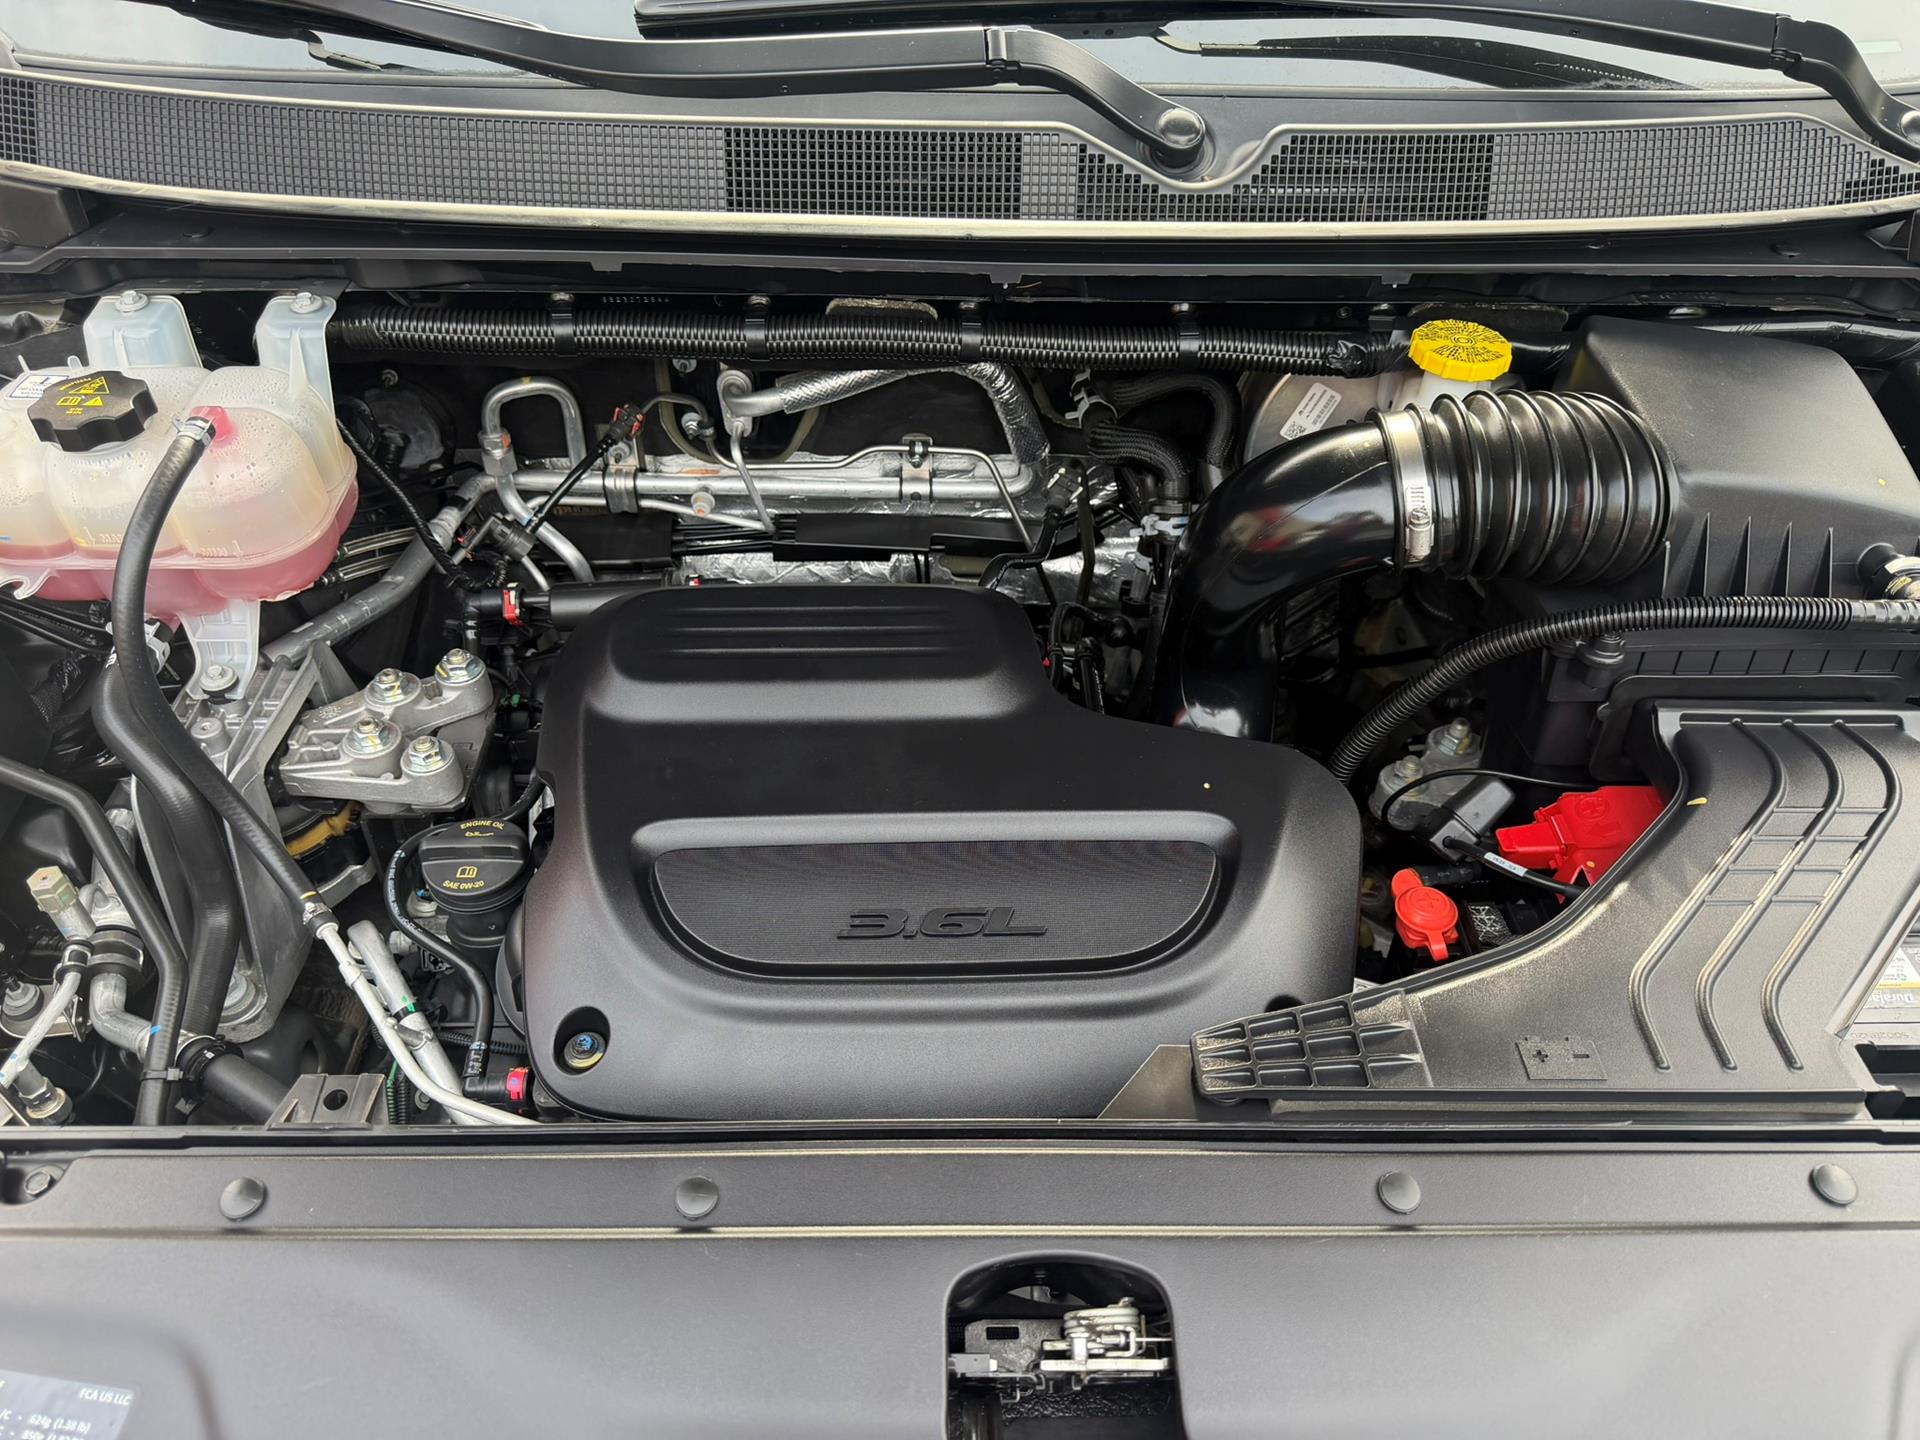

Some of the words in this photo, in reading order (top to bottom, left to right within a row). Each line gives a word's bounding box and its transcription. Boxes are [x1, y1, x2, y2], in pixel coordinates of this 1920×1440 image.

[460, 820, 491, 830] ENGINE
[492, 821, 505, 830] OIL
[442, 879, 459, 890] SAE
[459, 880, 485, 890] 0W-20
[836, 906, 1048, 939] 3.6L
[79, 1387, 98, 1400] FCA
[99, 1390, 113, 1403] US
[114, 1393, 133, 1406] LLC
